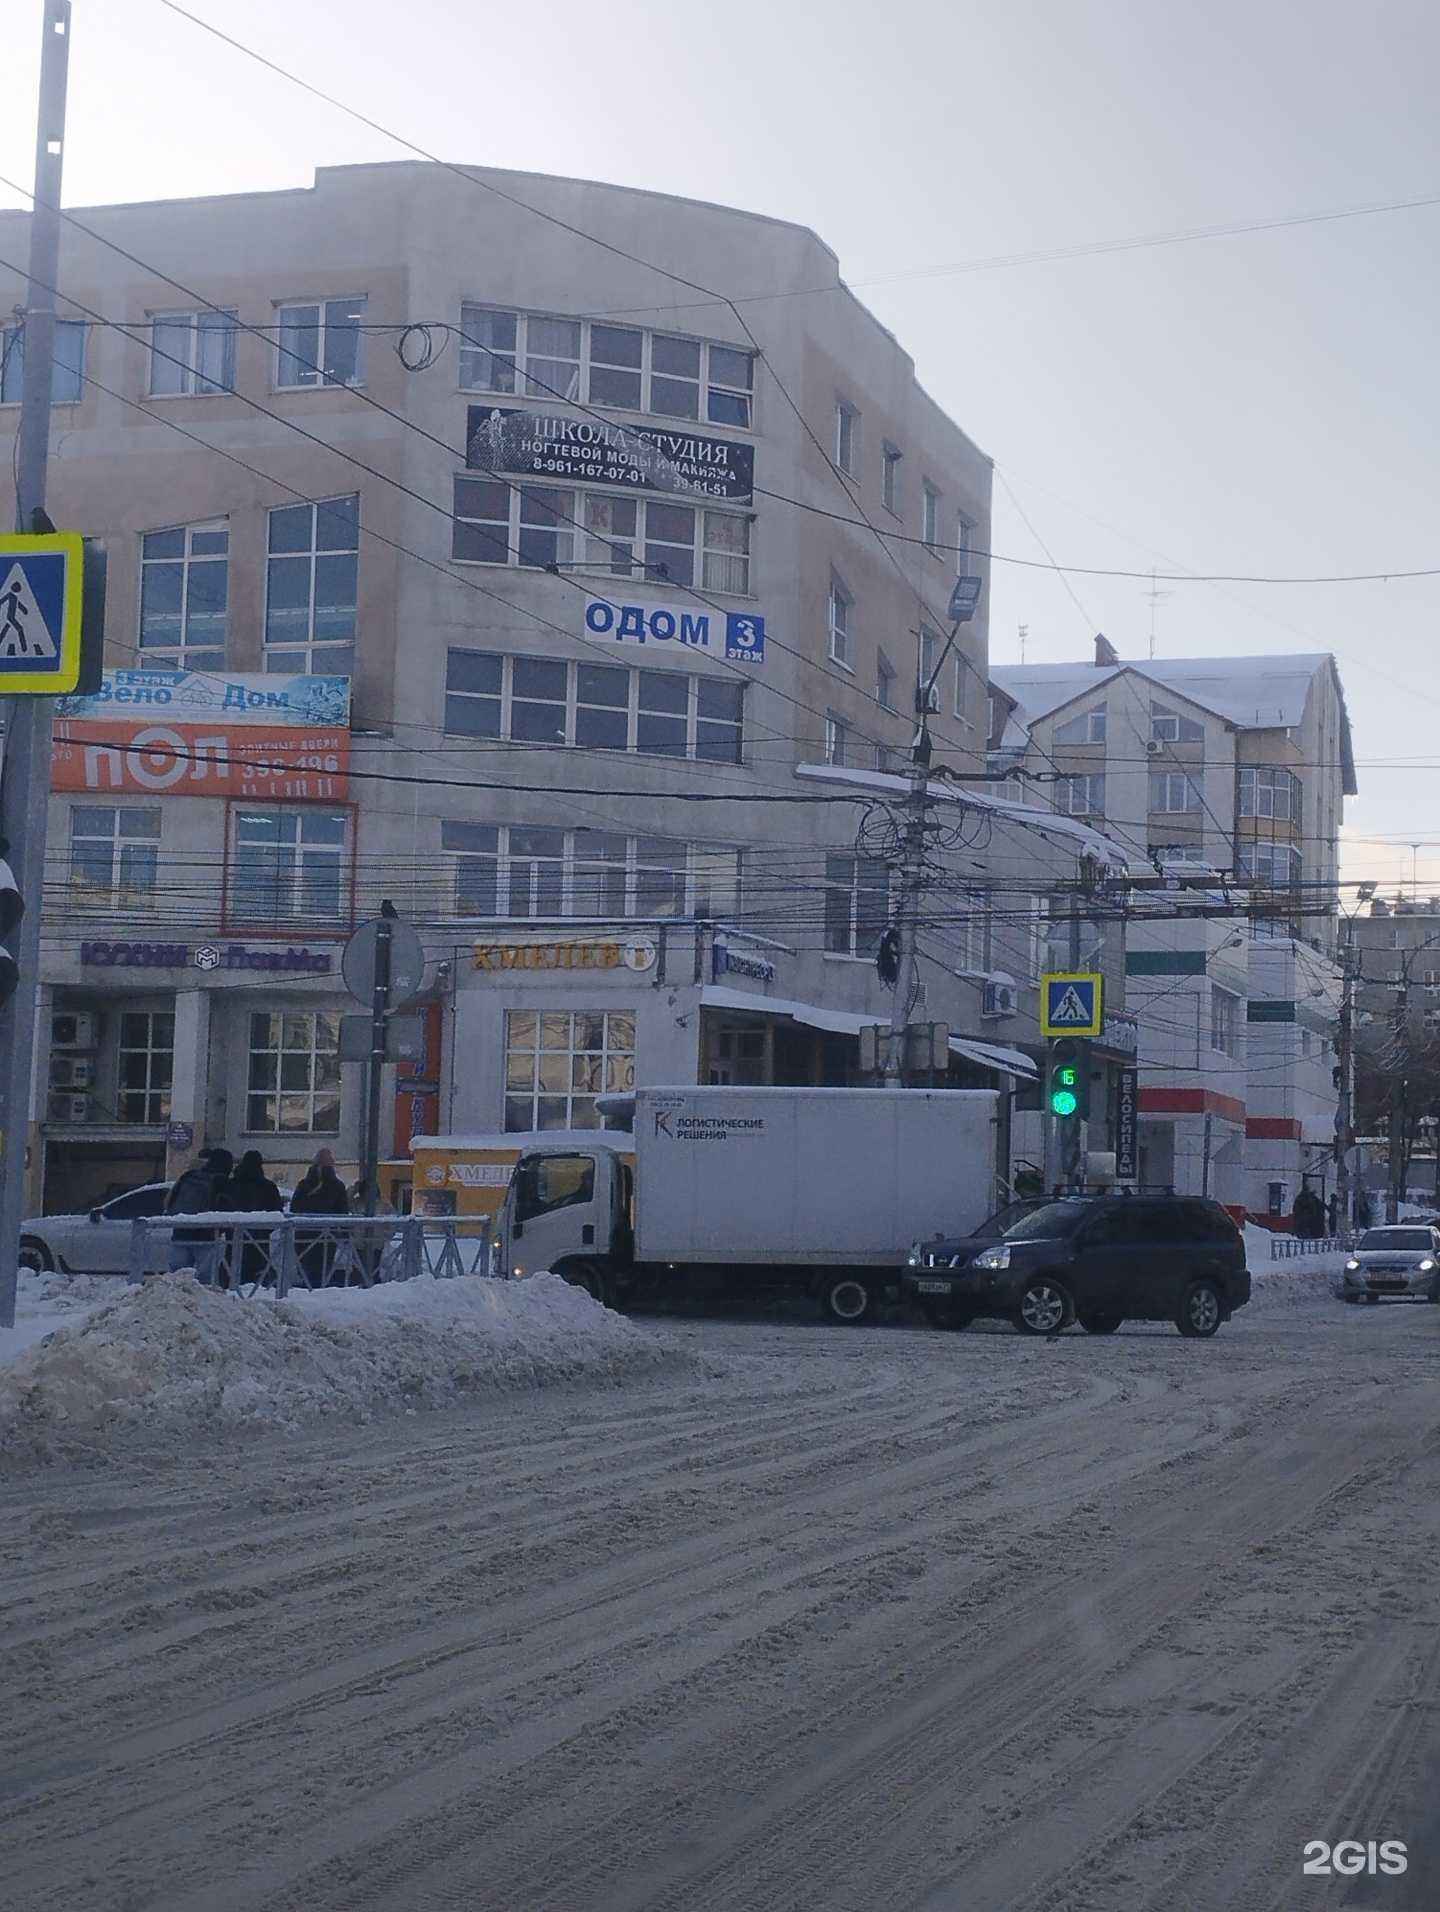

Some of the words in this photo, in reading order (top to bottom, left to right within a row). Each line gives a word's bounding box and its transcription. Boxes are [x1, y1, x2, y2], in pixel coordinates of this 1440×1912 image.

[521, 439, 602, 461] НОГТЕВОЙ
[606, 451, 651, 470] МОДЫ
[532, 457, 646, 483] 8-961-167-07-01
[585, 602, 710, 645] ОДОМ
[736, 619, 757, 647] 3
[676, 1118, 764, 1129] ЛОГИСТИЧЕСКИЕ
[677, 1130, 727, 1140] РЕШЕНИЯ
